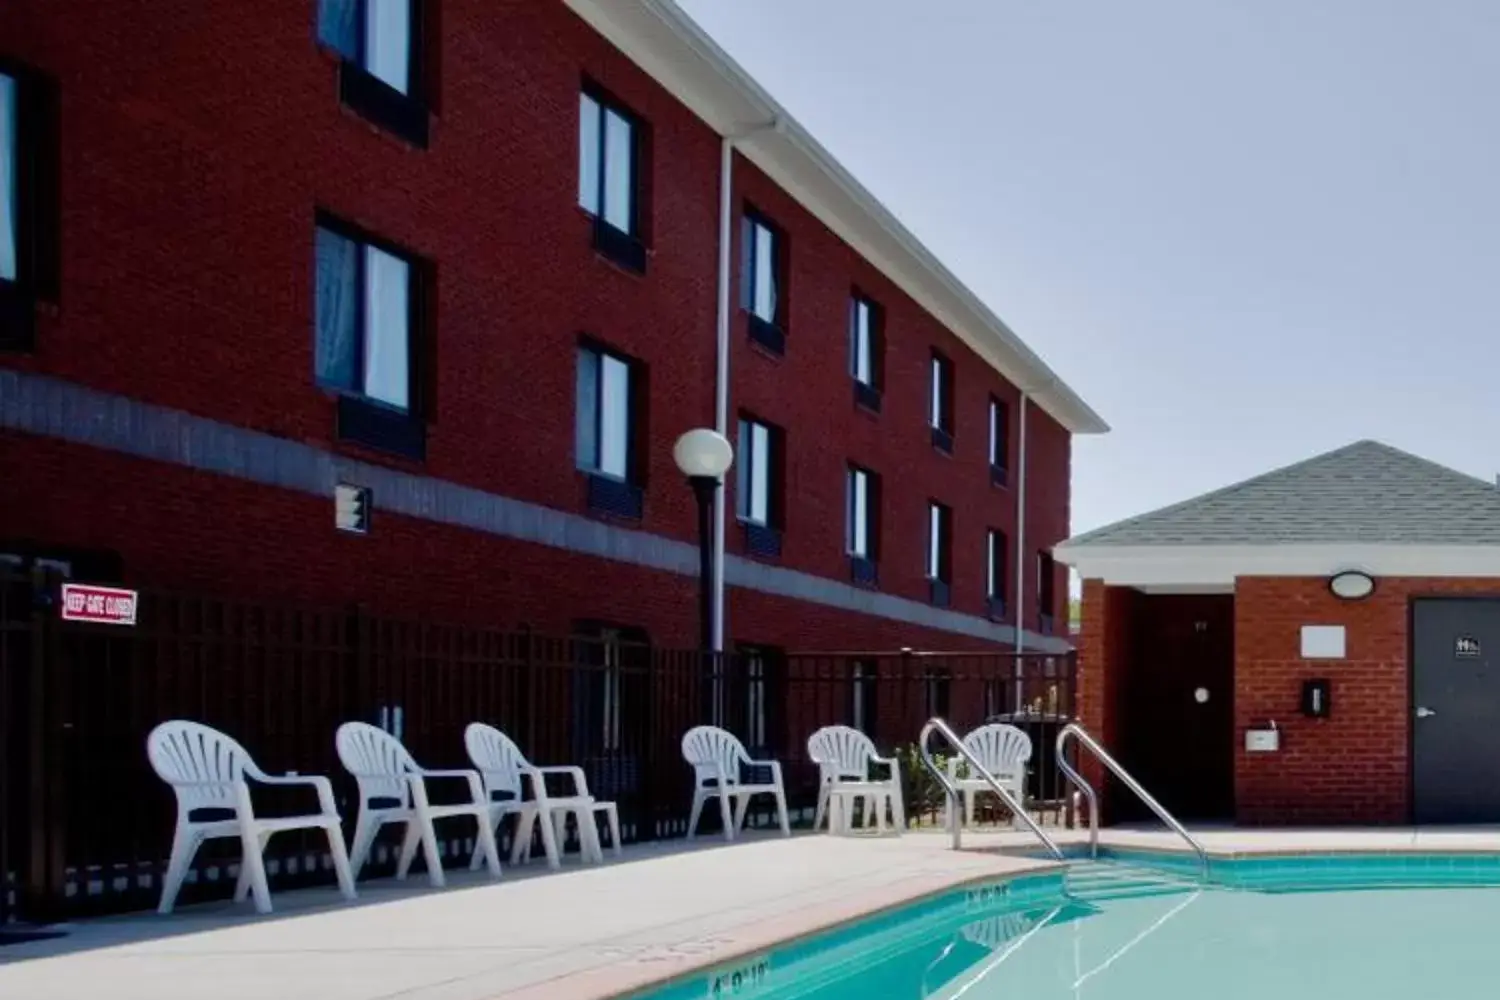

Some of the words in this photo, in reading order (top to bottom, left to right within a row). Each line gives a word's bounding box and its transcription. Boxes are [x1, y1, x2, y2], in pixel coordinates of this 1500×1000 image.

[67, 592, 85, 612] KEEP
[87, 594, 105, 615] GATE
[106, 596, 132, 617] CLOSED
